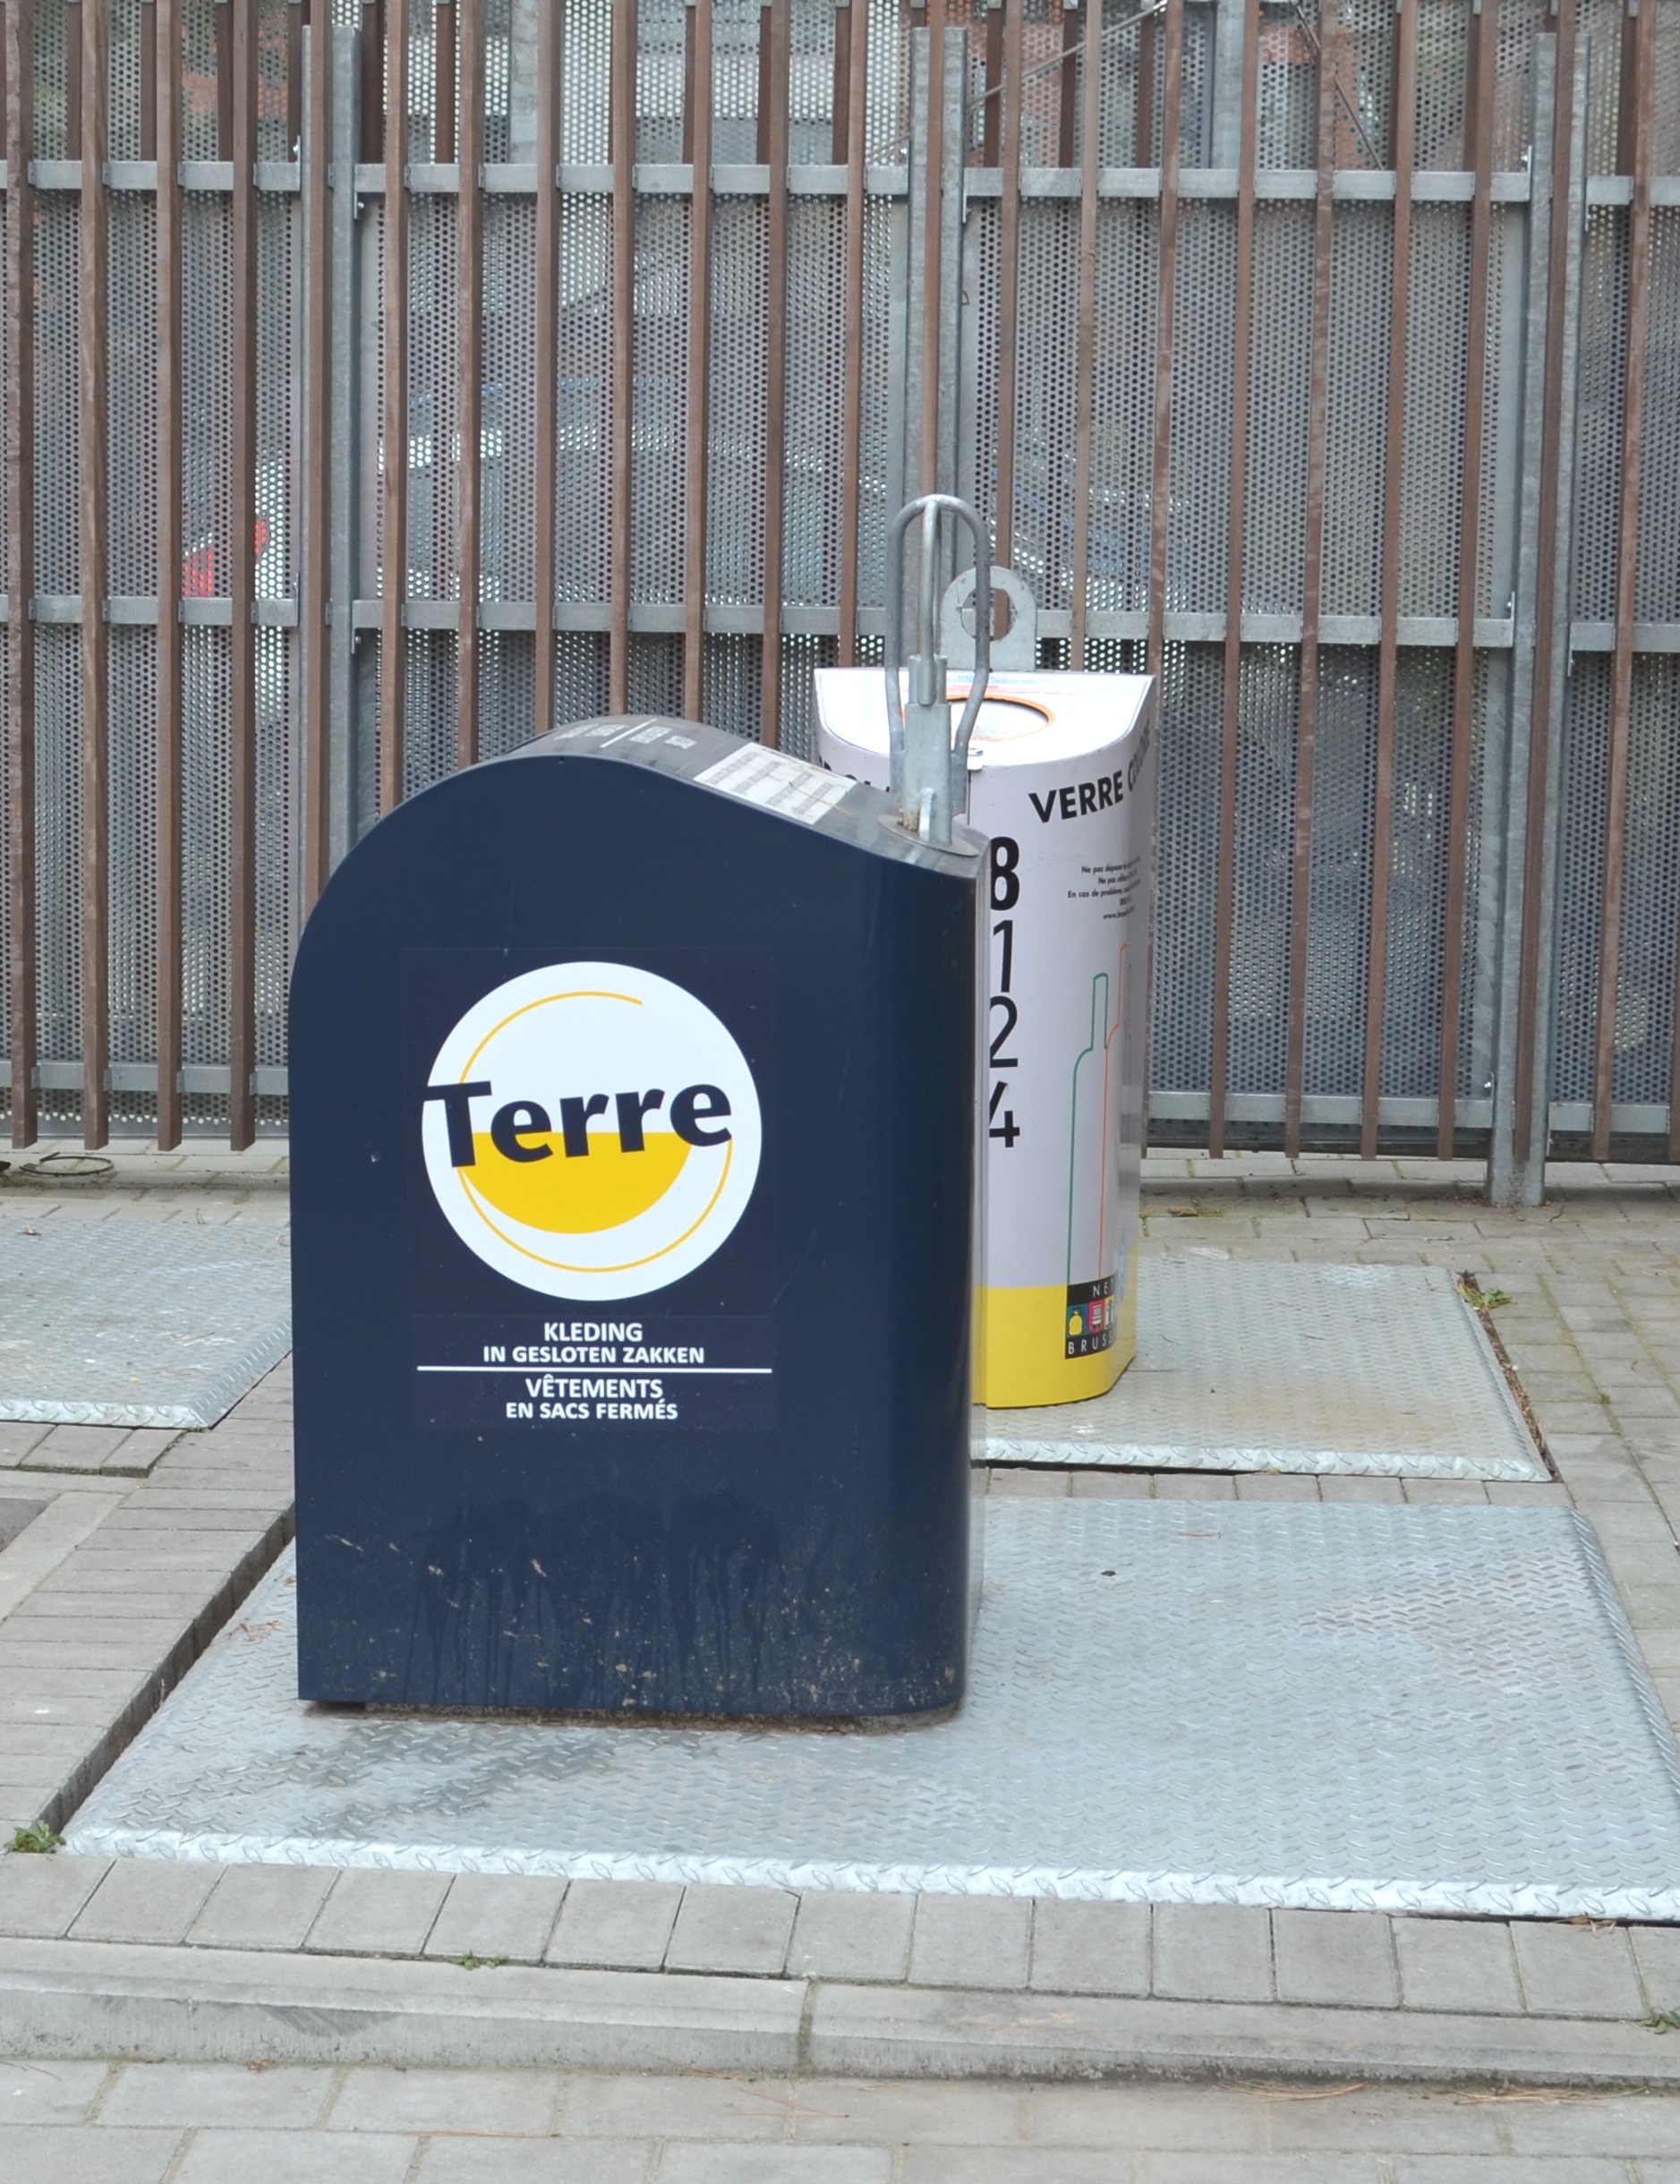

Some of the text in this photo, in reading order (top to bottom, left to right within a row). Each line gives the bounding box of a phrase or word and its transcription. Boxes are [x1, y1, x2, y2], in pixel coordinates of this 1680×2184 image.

[1028, 770, 1124, 823] VERRE
[423, 1079, 733, 1168] Terre
[544, 1322, 643, 1343] KLEDING
[483, 1346, 704, 1364] IN GESLOTEN ZAKKEN
[525, 1374, 663, 1399] VÊTEMENTS
[506, 1398, 678, 1420] EN SACS FERMÉS
